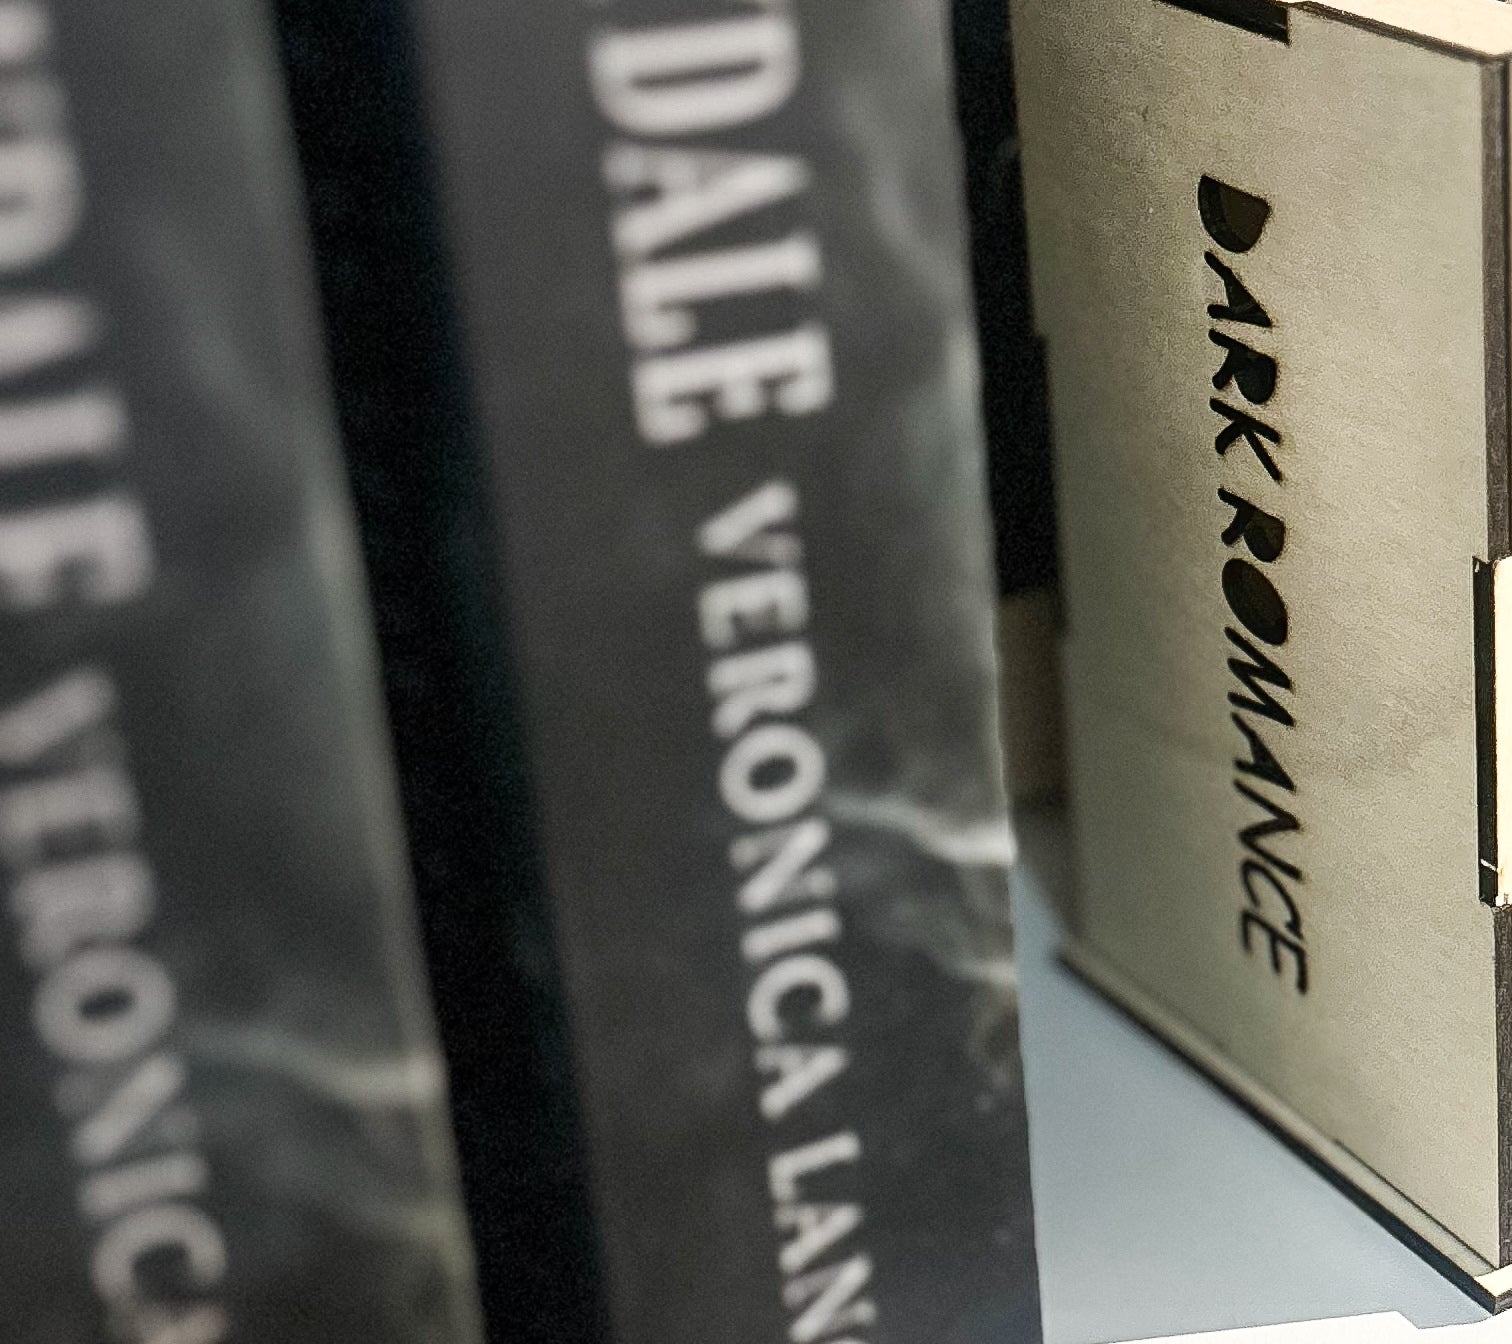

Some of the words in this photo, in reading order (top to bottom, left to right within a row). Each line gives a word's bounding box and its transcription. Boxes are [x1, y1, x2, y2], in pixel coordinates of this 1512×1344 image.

[1198, 174, 1285, 483] DARK
[698, 478, 851, 1122] VERONICA
[1217, 485, 1309, 996] ROMANCE
